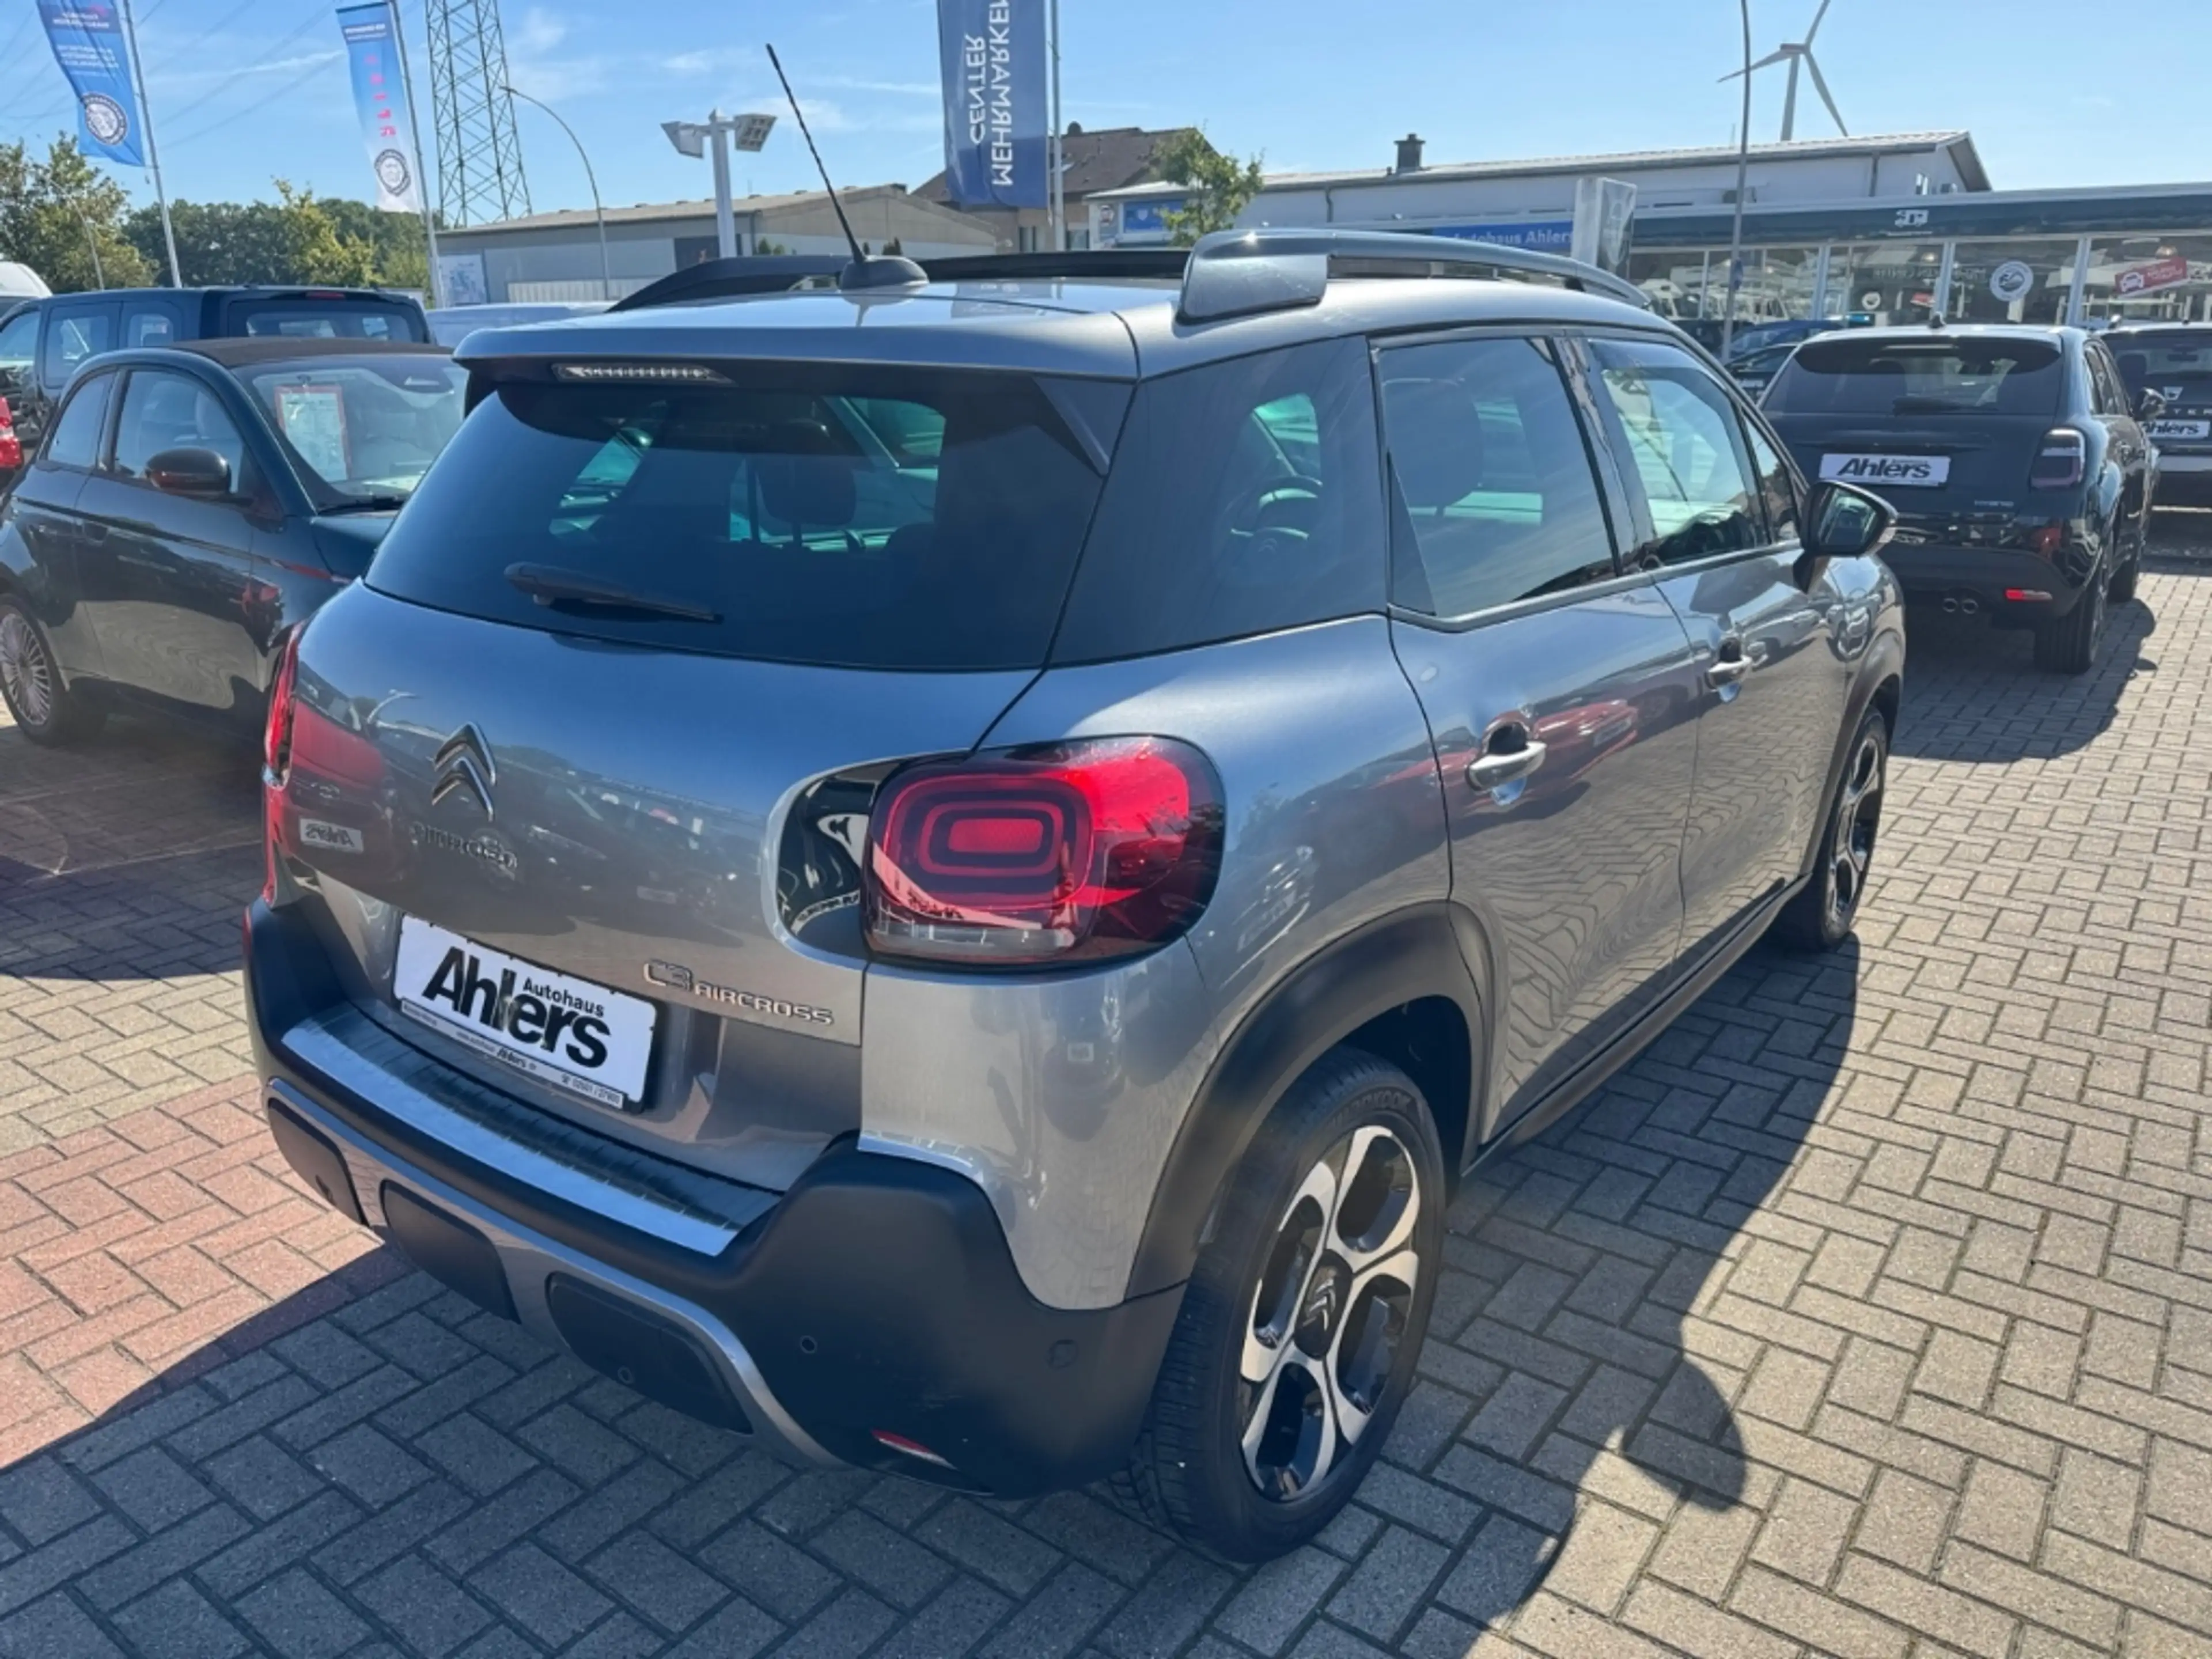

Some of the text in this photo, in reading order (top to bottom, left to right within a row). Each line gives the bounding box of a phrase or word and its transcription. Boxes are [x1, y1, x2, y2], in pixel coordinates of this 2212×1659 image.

[1837, 457, 1932, 478] Ahlers
[422, 946, 612, 1068] Ahlers
[523, 977, 605, 1017] Autohaus
[694, 980, 834, 1027] AIRCROSS
